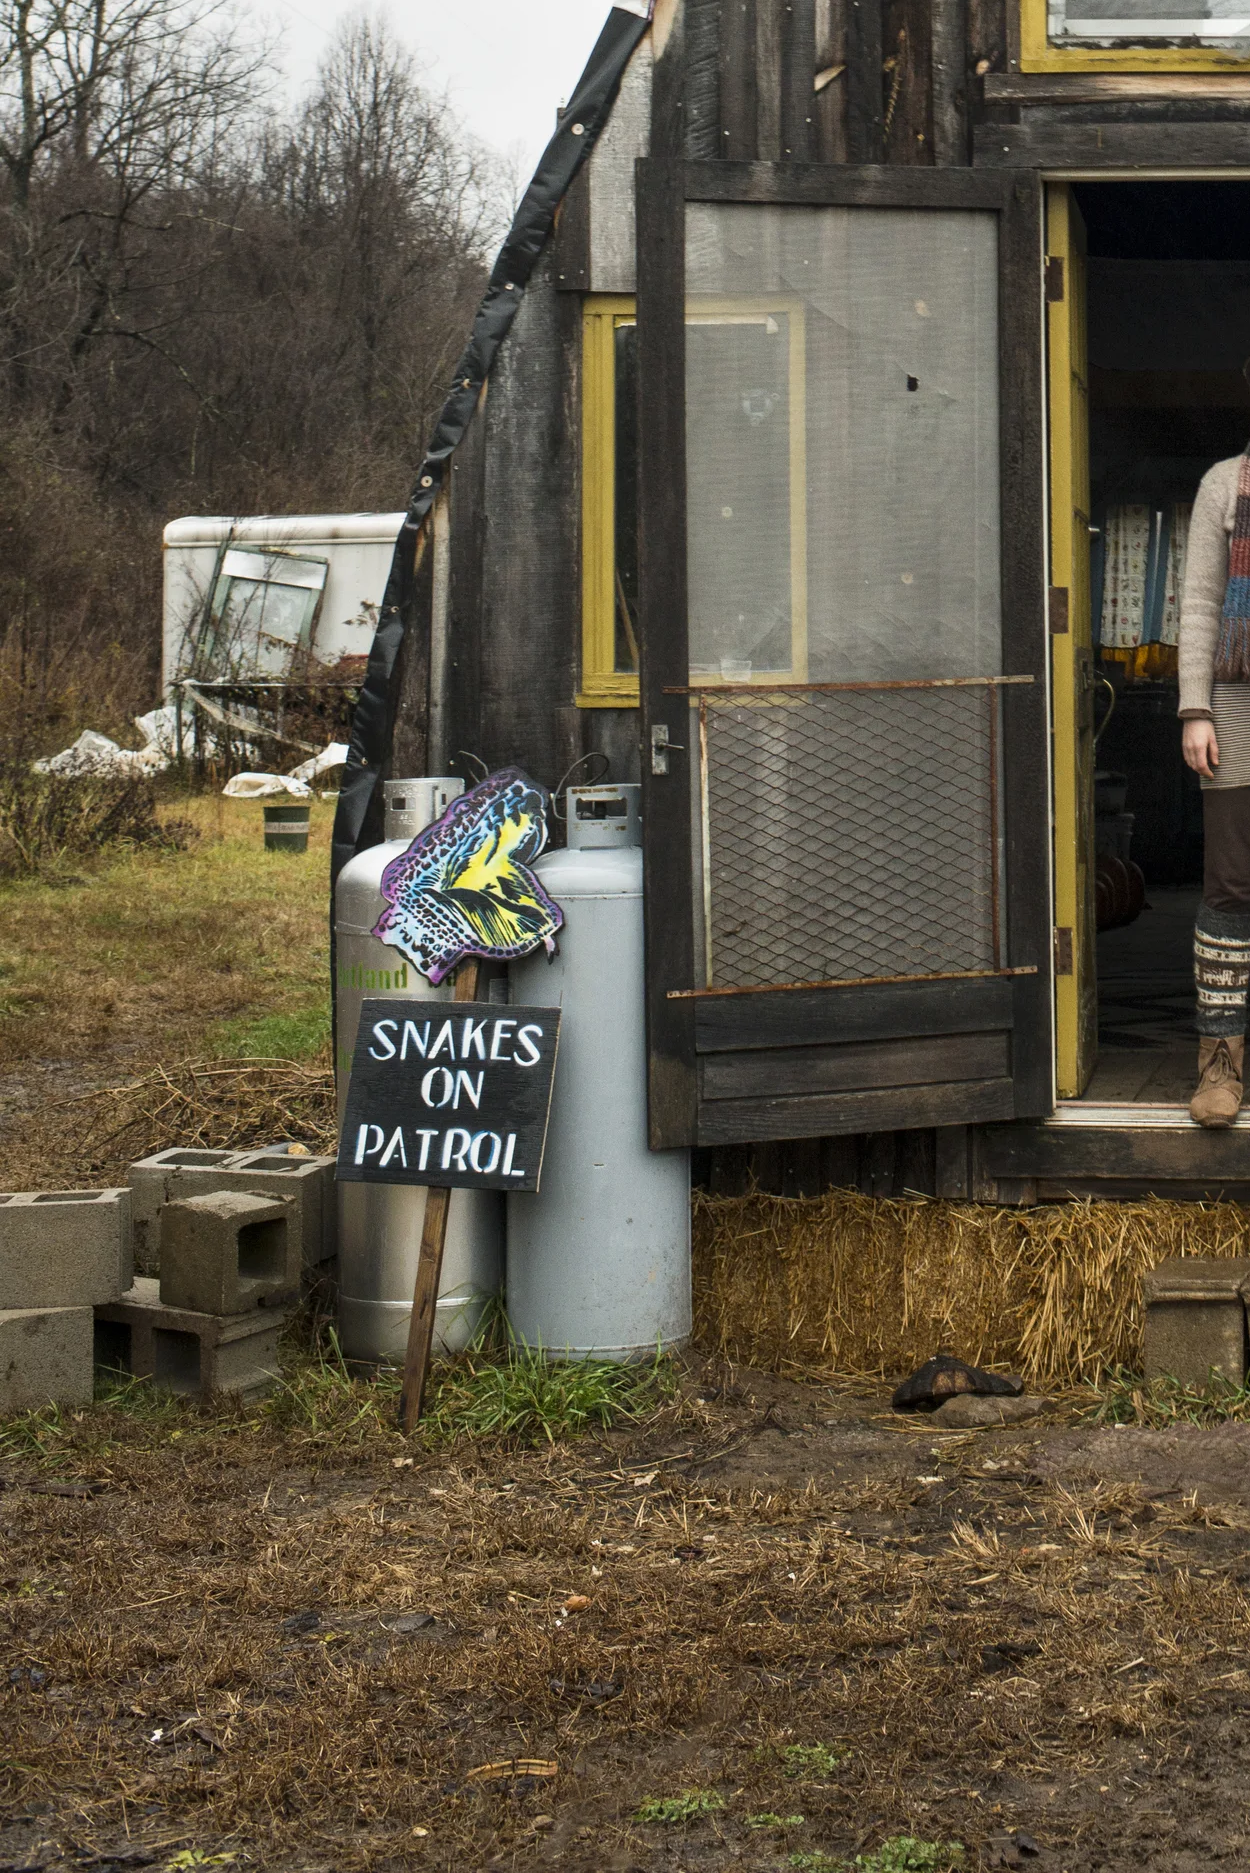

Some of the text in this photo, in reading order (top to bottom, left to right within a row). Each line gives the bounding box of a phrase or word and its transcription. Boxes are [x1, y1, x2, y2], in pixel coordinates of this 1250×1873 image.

[367, 1017, 544, 1067] SNAKES
[420, 1066, 485, 1110] ON
[353, 1123, 526, 1177] PATROL
